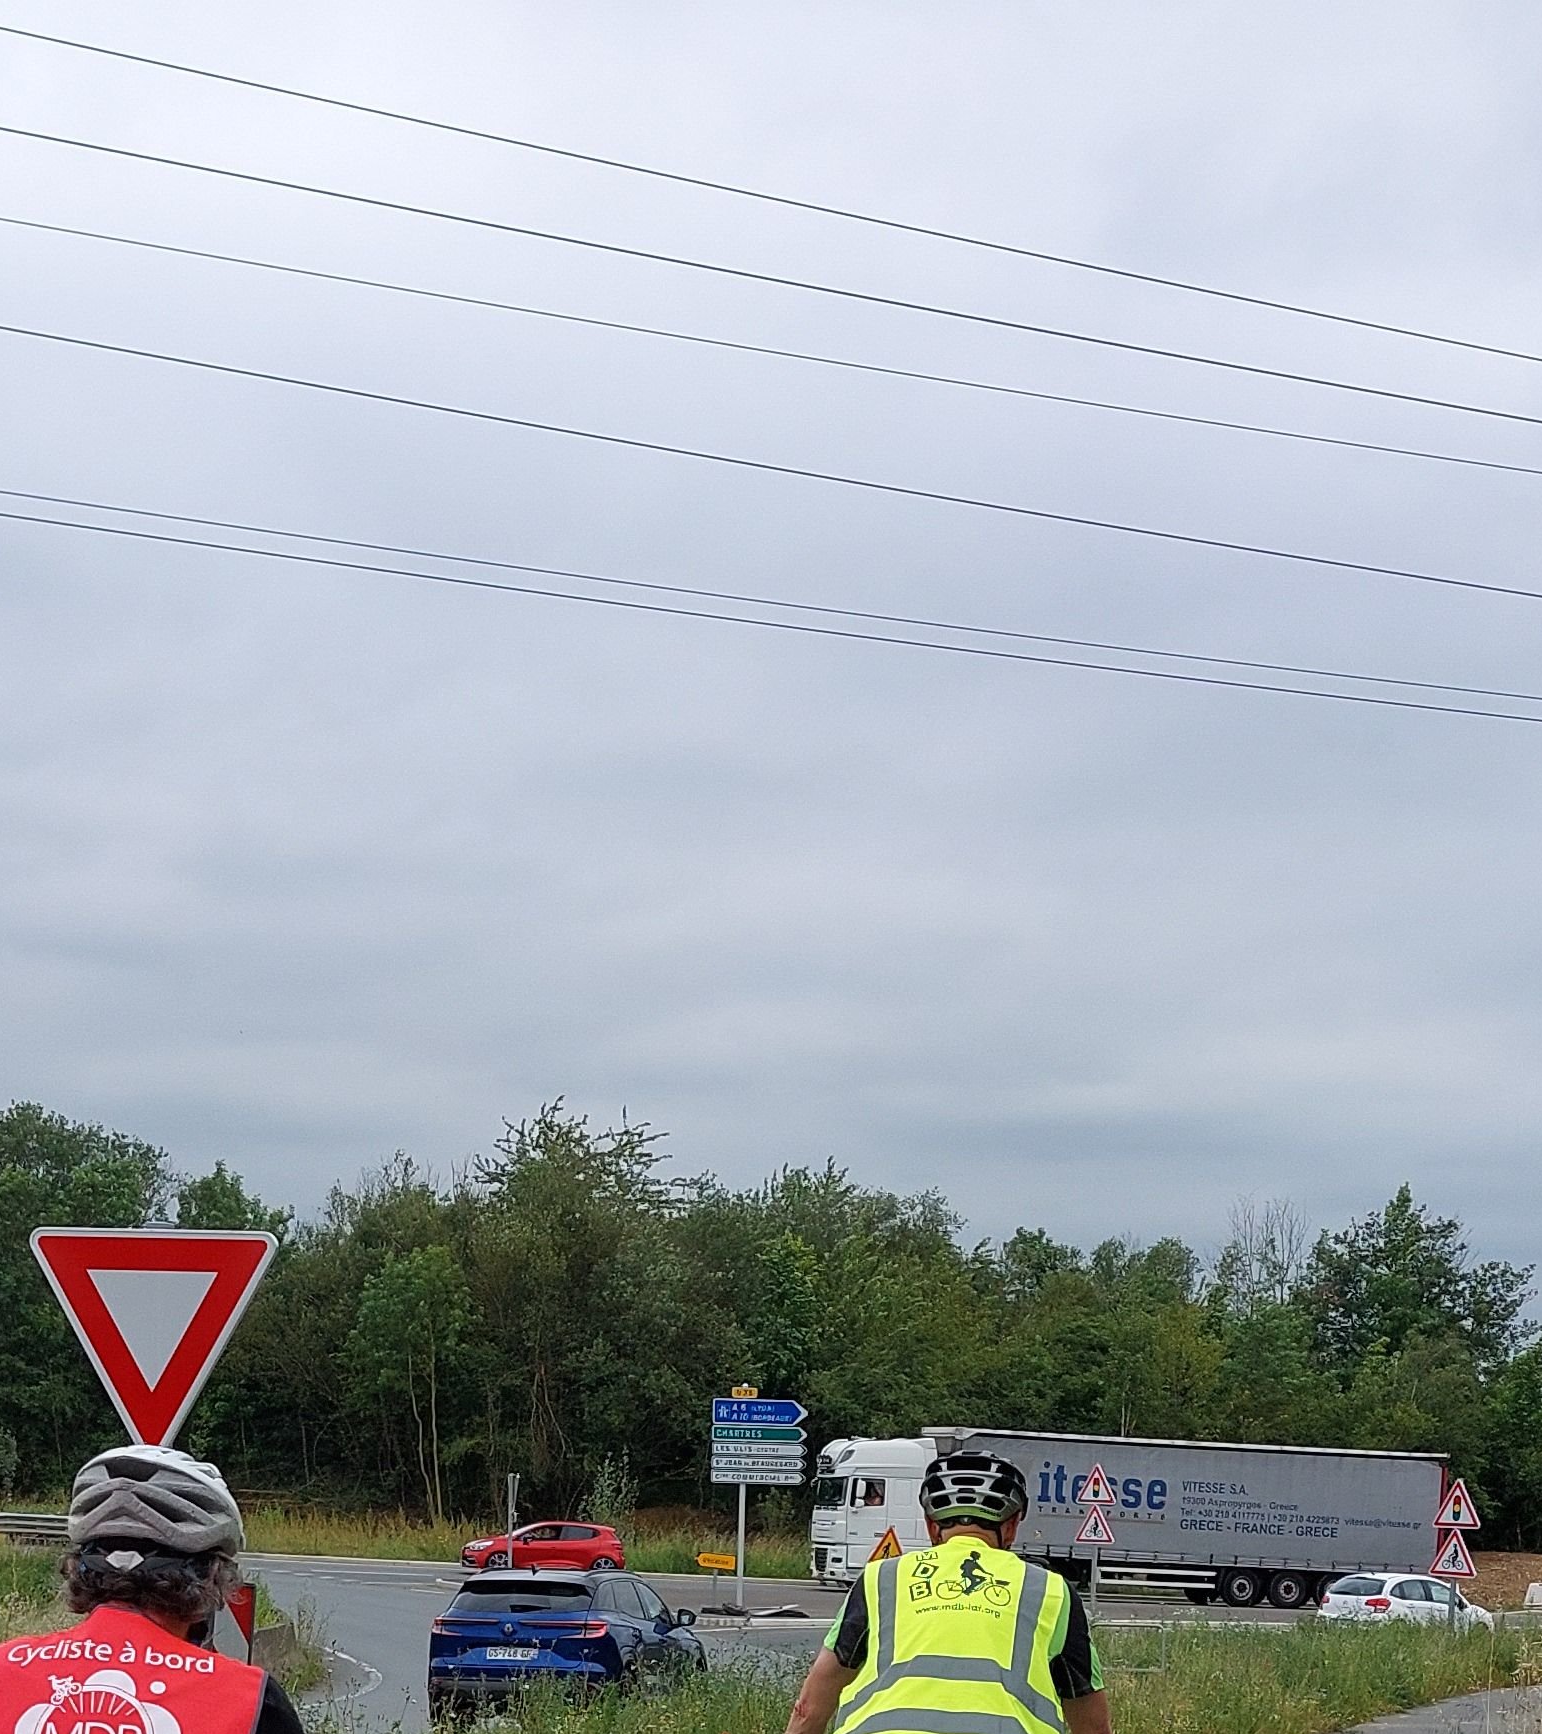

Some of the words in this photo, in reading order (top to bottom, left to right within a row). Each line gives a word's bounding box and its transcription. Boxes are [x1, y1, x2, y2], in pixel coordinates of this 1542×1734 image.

[731, 1403, 739, 1412] A
[731, 1412, 738, 1421] A
[716, 1429, 763, 1438] CHARTRES
[1182, 1480, 1227, 1494] VITESSE
[1229, 1483, 1249, 1496] S.A.
[1180, 1519, 1224, 1532] GRECE
[1234, 1522, 1285, 1536] FRANCE
[1296, 1525, 1339, 1538] GRECE
[8, 1639, 112, 1667] Cycliste
[118, 1641, 137, 1663] à
[145, 1646, 215, 1673] bord
